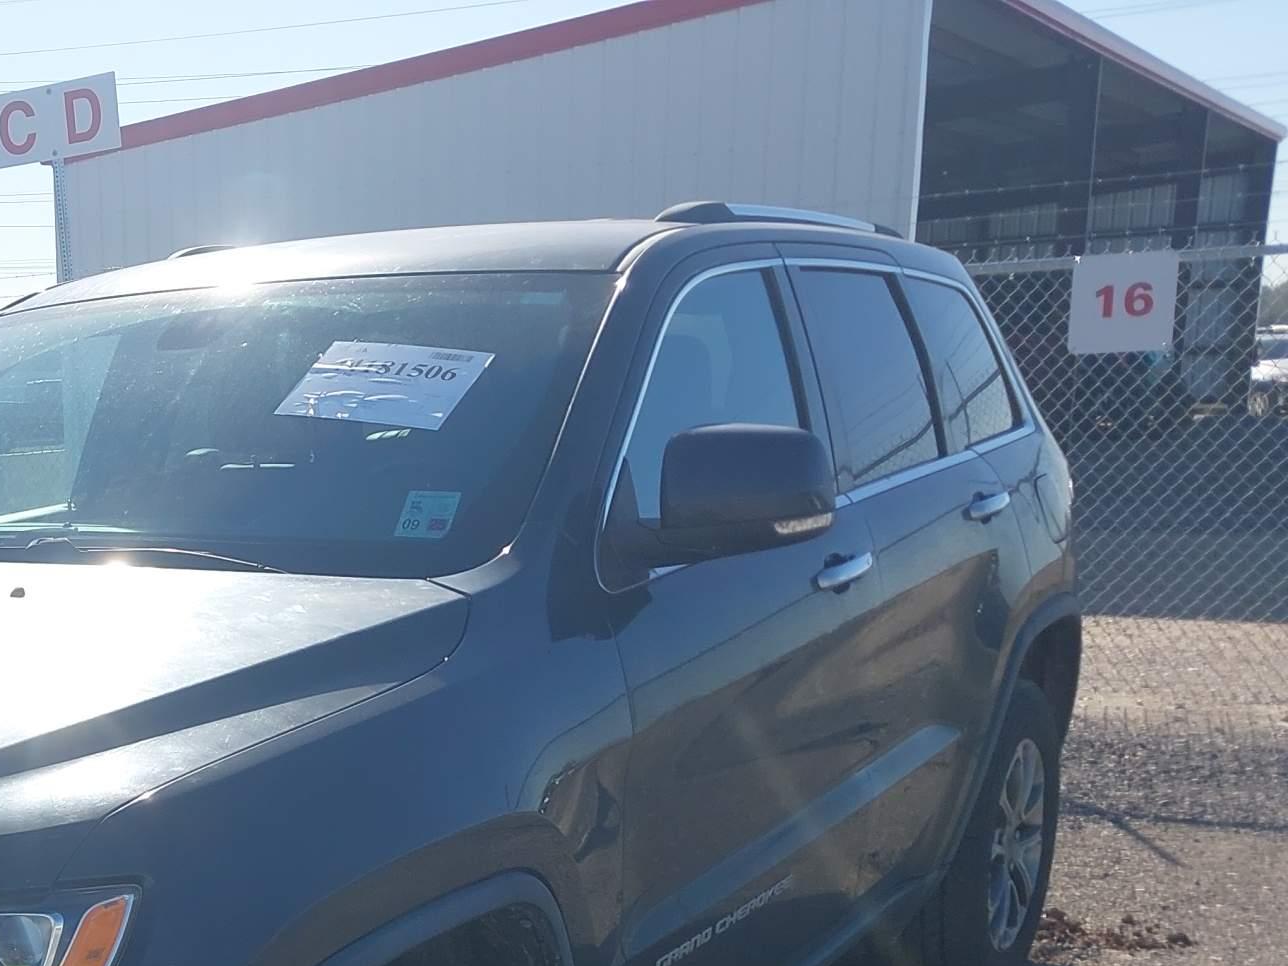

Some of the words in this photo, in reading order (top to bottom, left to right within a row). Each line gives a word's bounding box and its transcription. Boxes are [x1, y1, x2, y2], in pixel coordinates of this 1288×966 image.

[63, 88, 101, 144] D
[1095, 282, 1154, 318] 16
[715, 873, 794, 934] CHEROKEE
